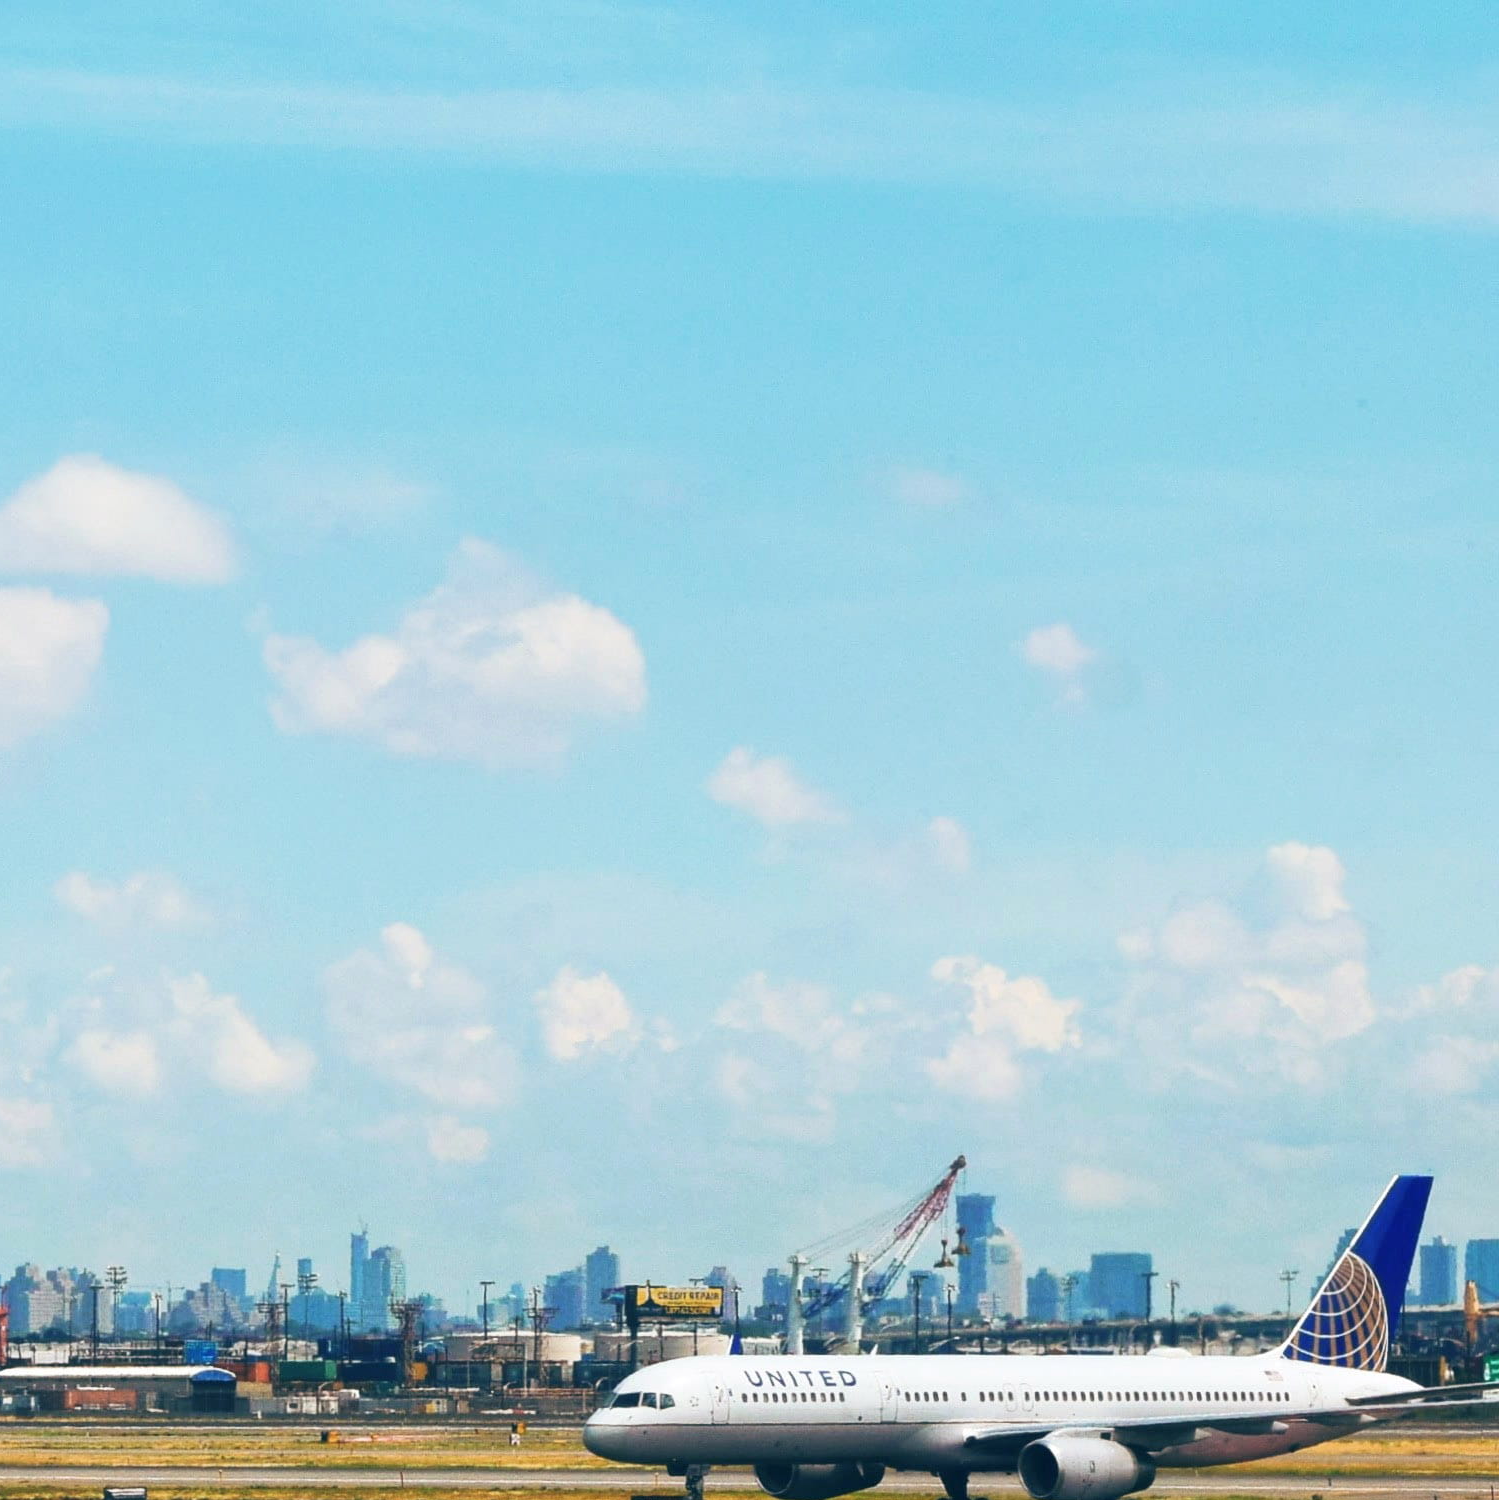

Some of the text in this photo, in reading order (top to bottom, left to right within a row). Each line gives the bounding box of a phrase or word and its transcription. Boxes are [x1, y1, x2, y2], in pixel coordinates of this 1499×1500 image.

[657, 1291, 720, 1301] CREDIT REPAIR
[744, 1370, 857, 1387] UNITED
